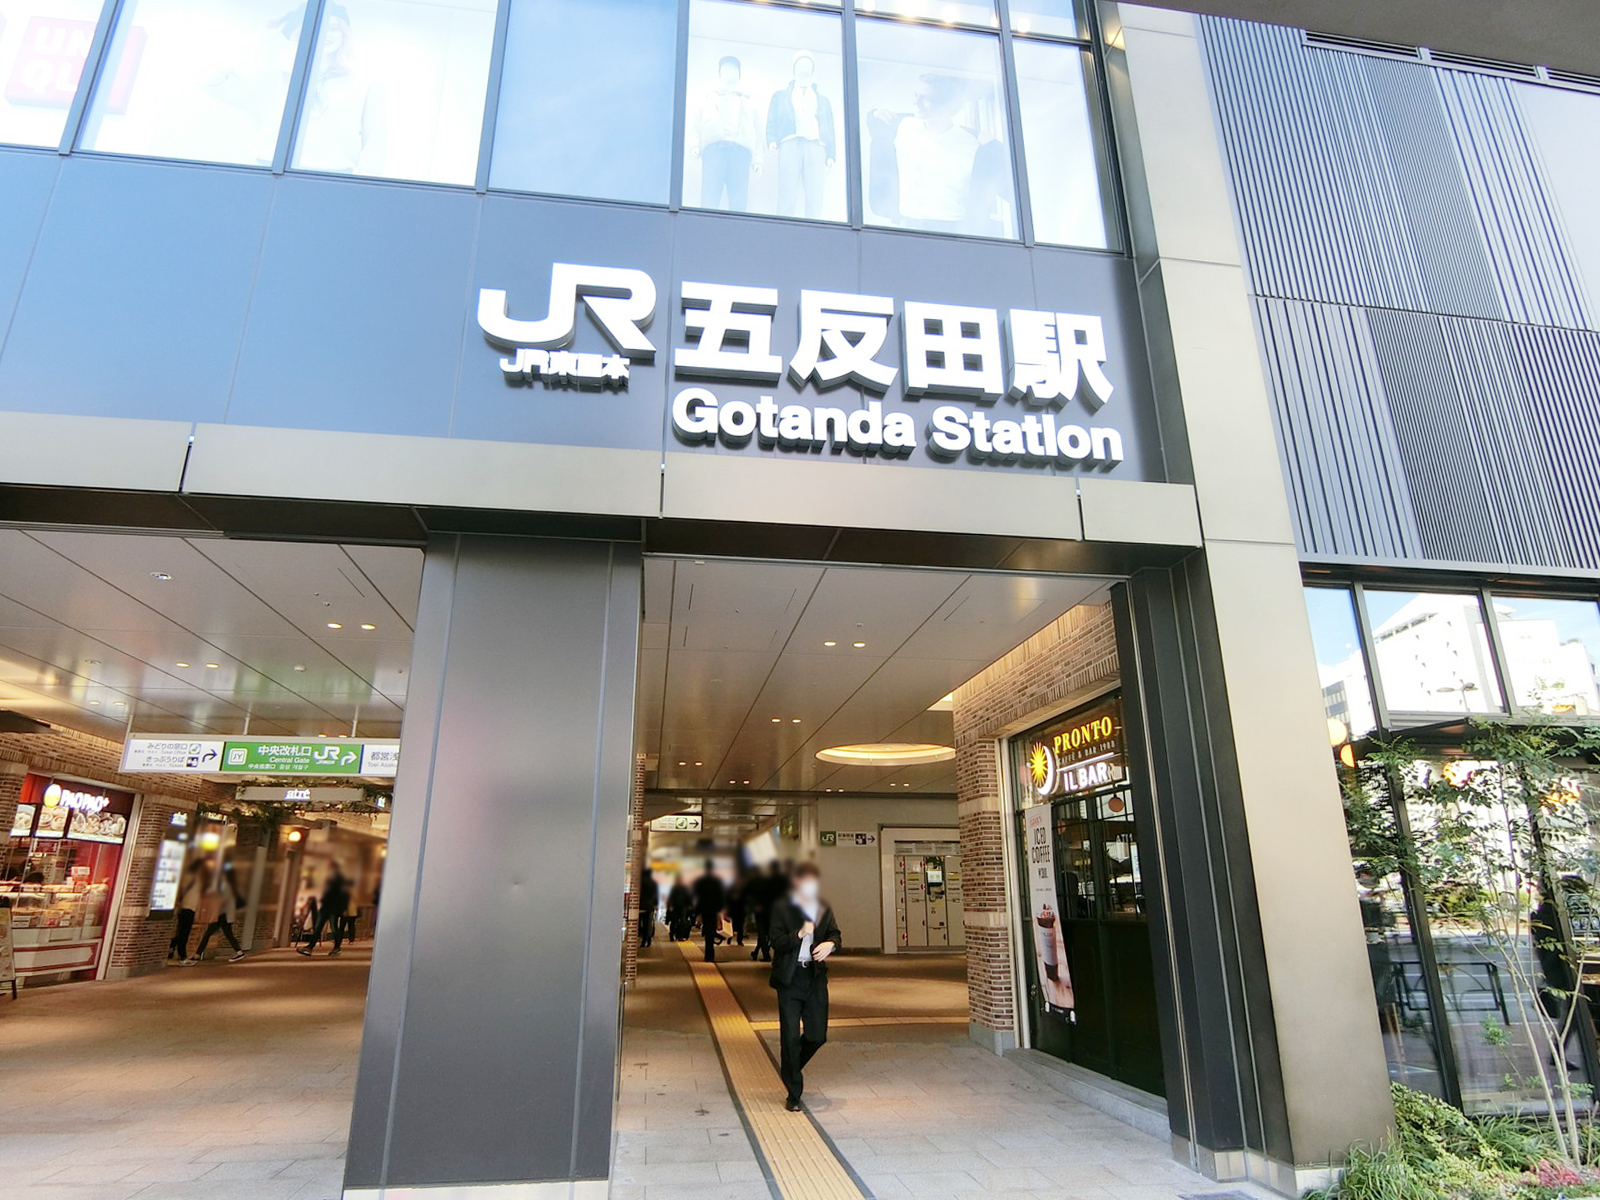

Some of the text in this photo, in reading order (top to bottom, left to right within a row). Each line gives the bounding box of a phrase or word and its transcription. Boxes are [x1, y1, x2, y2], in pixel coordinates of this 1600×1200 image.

[477, 262, 657, 351] JR
[674, 280, 1114, 404] 五反田駅
[671, 387, 916, 449] Gotanda
[1053, 716, 1112, 754] PRONTO
[232, 751, 243, 760] JY
[258, 745, 312, 756] 中央改札口
[269, 756, 293, 764] Central
[313, 746, 340, 760] JR
[1084, 746, 1097, 756] BAR
[1063, 762, 1108, 792] IL BAR
[821, 833, 835, 842] JR
[1034, 826, 1047, 845] ICED
[1031, 845, 1051, 864] COFFEE
